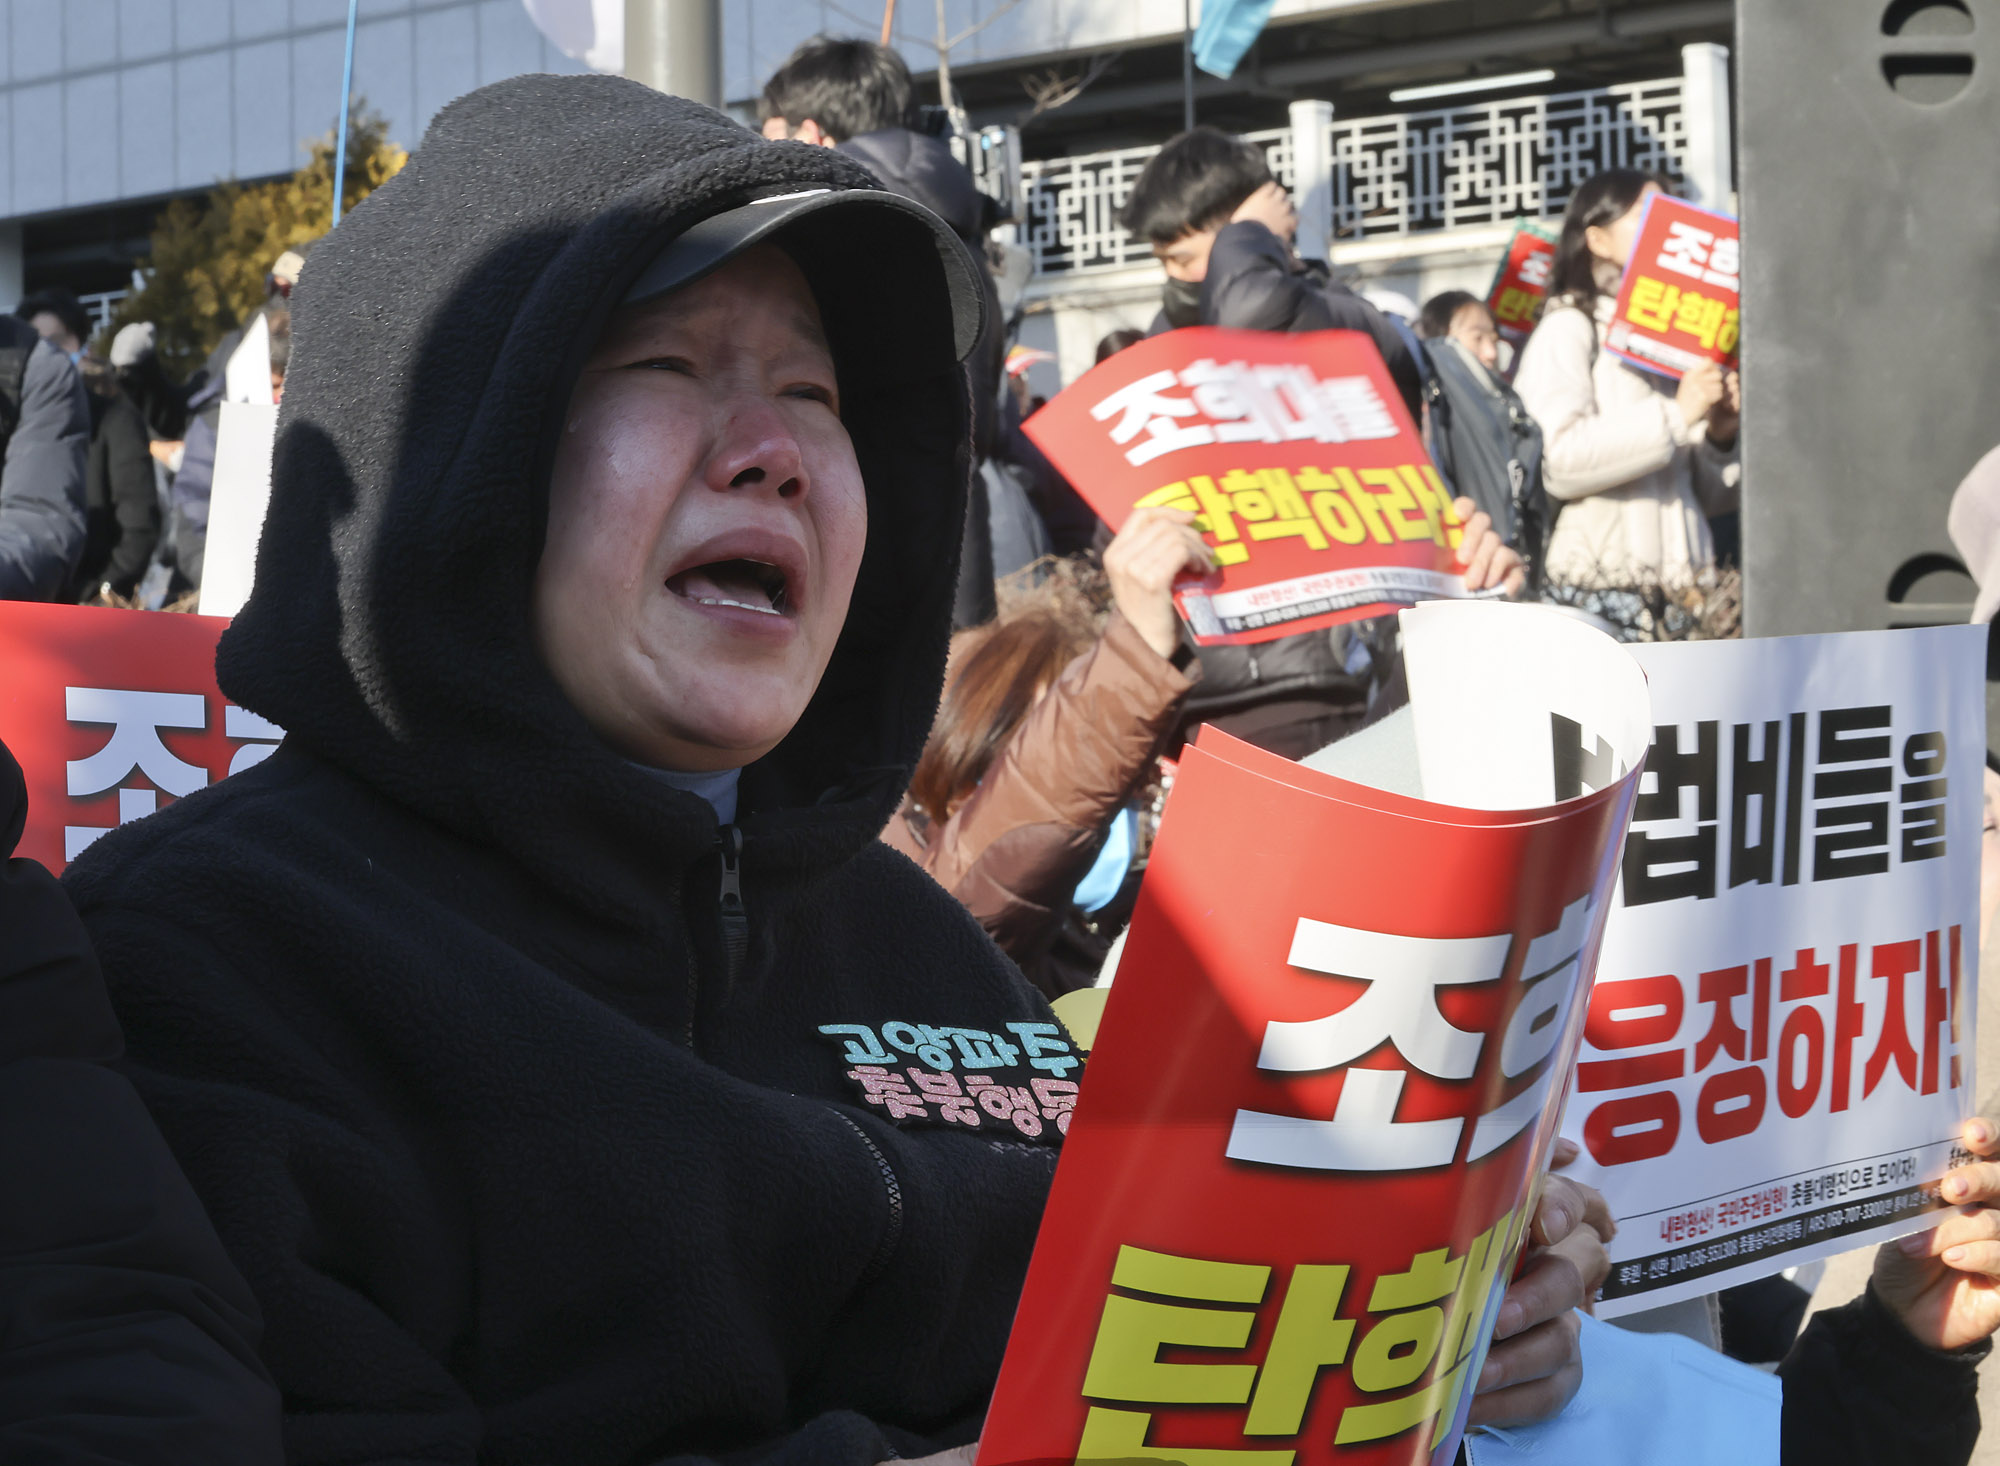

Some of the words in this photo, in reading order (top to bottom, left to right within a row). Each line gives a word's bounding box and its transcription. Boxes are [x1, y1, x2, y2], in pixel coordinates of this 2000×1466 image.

[1090, 358, 1400, 467] 조희대를
[1133, 464, 1463, 567] 탄핵하라!
[817, 1020, 1079, 1078] 고양파주
[1577, 924, 1962, 1167] 응징하자!
[1717, 1185, 1788, 1228] 국민주권실현!
[1790, 1166, 1874, 1208] 촛불대행진으로
[1876, 1156, 1917, 1186] 모이자!
[1619, 1263, 1642, 1286] 후원
